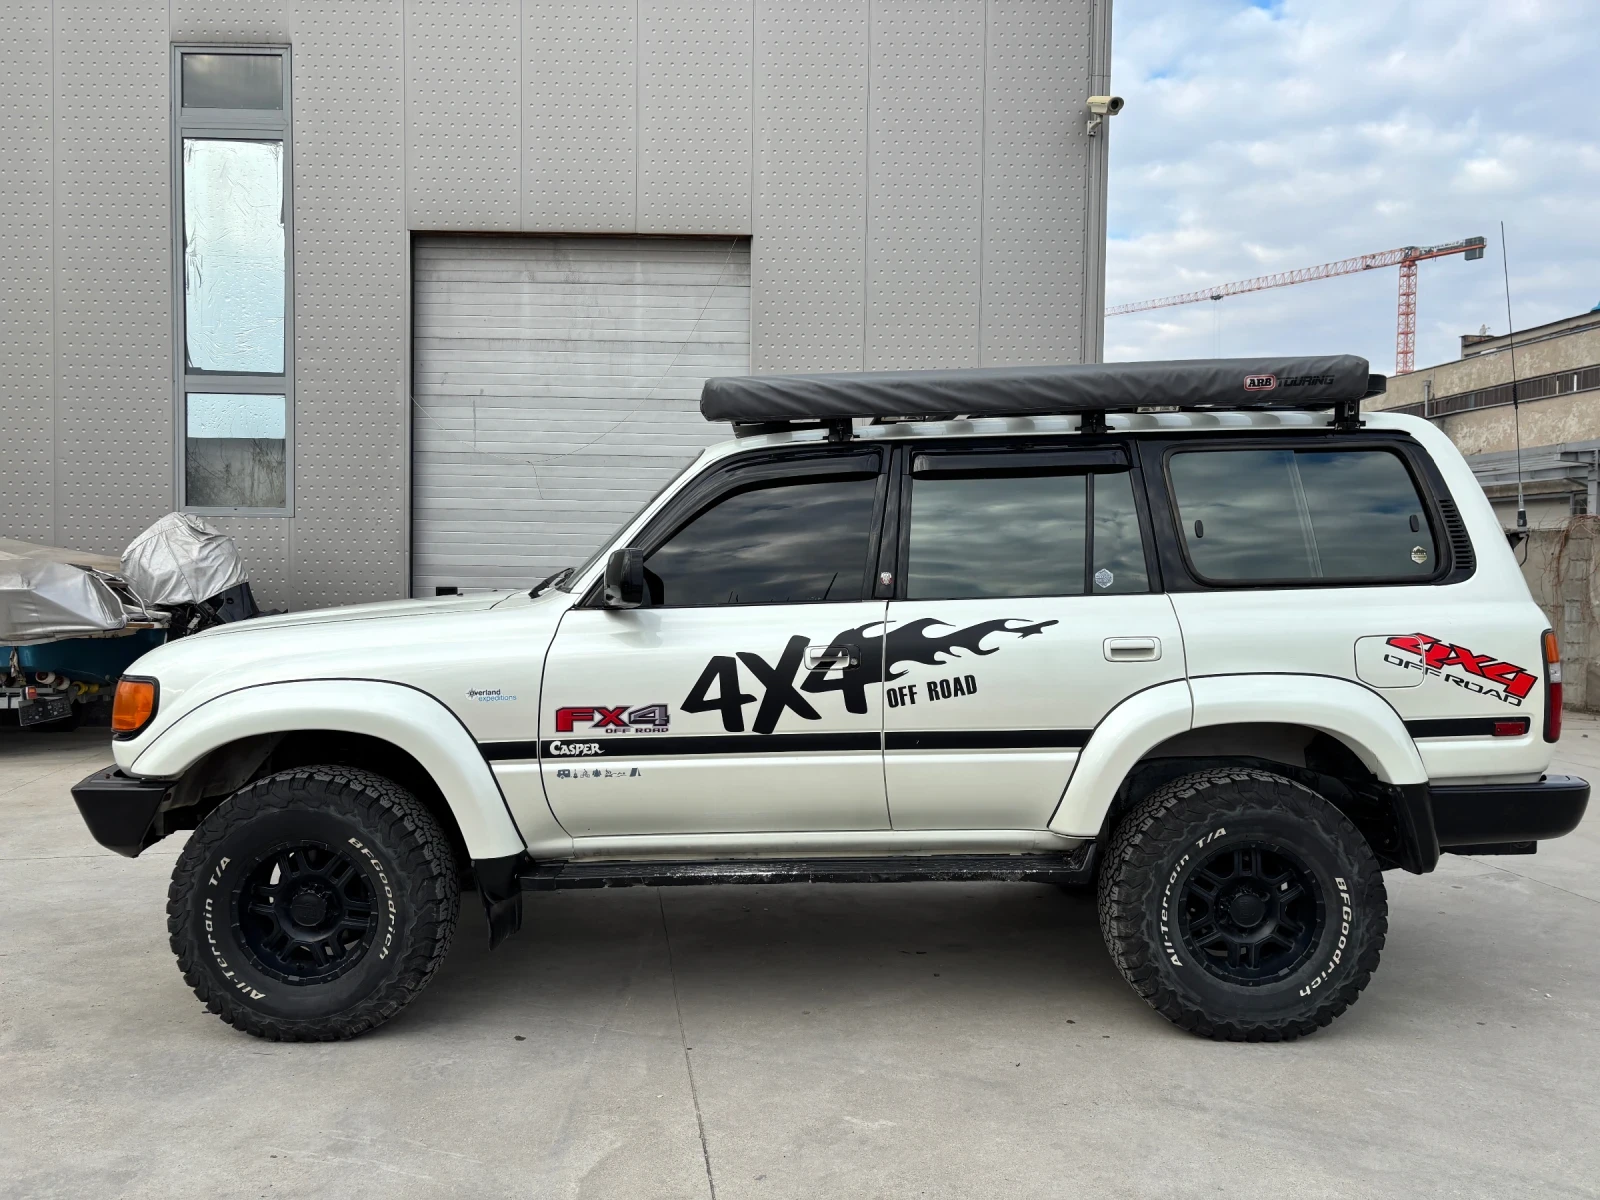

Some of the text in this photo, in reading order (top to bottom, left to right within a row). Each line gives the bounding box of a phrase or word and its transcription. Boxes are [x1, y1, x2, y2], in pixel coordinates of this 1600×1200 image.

[1249, 375, 1335, 388] ARB TOURING
[478, 694, 517, 702] expeditions
[680, 627, 868, 735] 4X4
[886, 674, 978, 708] OFF ROAD
[1383, 654, 1522, 707] OFF ROAD
[1385, 633, 1538, 699] 4X4
[555, 704, 671, 733] FX4
[203, 856, 266, 1000] All-Terrain T/A
[347, 837, 396, 960] BFGoodrich
[1160, 827, 1227, 967] All-Terrain T/A
[1299, 877, 1352, 997] BFGoodrich
